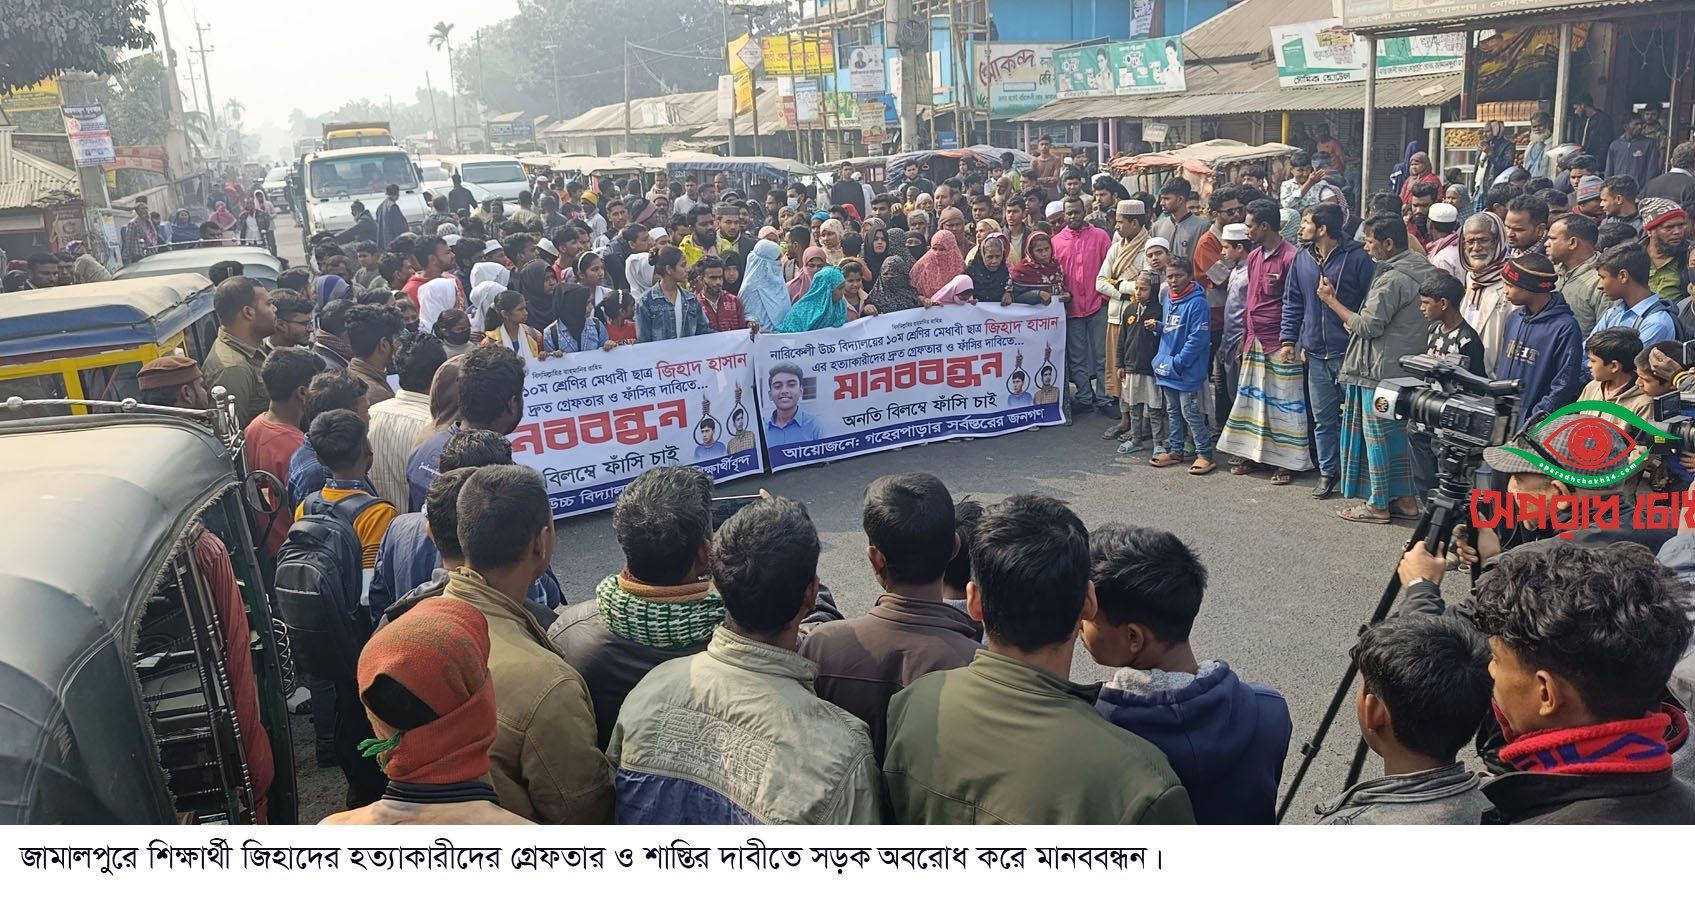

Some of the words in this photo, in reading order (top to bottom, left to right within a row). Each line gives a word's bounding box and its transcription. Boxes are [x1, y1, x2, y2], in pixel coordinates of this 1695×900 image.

[769, 343, 815, 361] নারিকেলী
[818, 342, 836, 355] উচ্চ
[838, 335, 885, 353] বিদ্যালয়ের
[886, 332, 904, 345] ১০ম
[906, 326, 931, 341] শ্রেণির
[933, 322, 964, 337] মেধাবী
[966, 323, 982, 335] ছাত্র
[984, 318, 1022, 335] জিহাদ
[1026, 316, 1059, 331] হাসান
[812, 361, 827, 373] এর
[830, 352, 886, 370] হত্যাকারীদের
[887, 348, 905, 361] দ্রুত
[907, 343, 942, 358] গ্রেফতার
[945, 342, 955, 353] ও
[957, 338, 983, 352] ফাঁসির
[523, 383, 548, 397] ১০ম
[552, 375, 587, 393] শ্রেণির
[592, 368, 628, 387] মেধাবী
[631, 366, 653, 382] ছাত্র
[655, 360, 702, 380] জিহাদ
[706, 353, 747, 371] হাসান
[833, 352, 1003, 400] মানববন্ধন
[528, 402, 553, 417] দ্রুত
[557, 394, 604, 412] গ্রেফতার
[608, 392, 618, 403] ও
[621, 384, 656, 402] ফাঁসির
[842, 406, 884, 428] অনতি
[887, 401, 928, 422] বিলম্বে
[933, 393, 968, 412] ফাঁসি
[972, 392, 998, 409] চাই
[781, 437, 860, 460] আয়োজনে:
[864, 420, 943, 446] গহেরপাড়ার
[946, 414, 1004, 431] সর্বস্তরের
[1008, 408, 1045, 424] জনগণ
[543, 466, 597, 489] বিলম্বে
[602, 451, 645, 475] ফাঁসি
[651, 444, 680, 466] চাই
